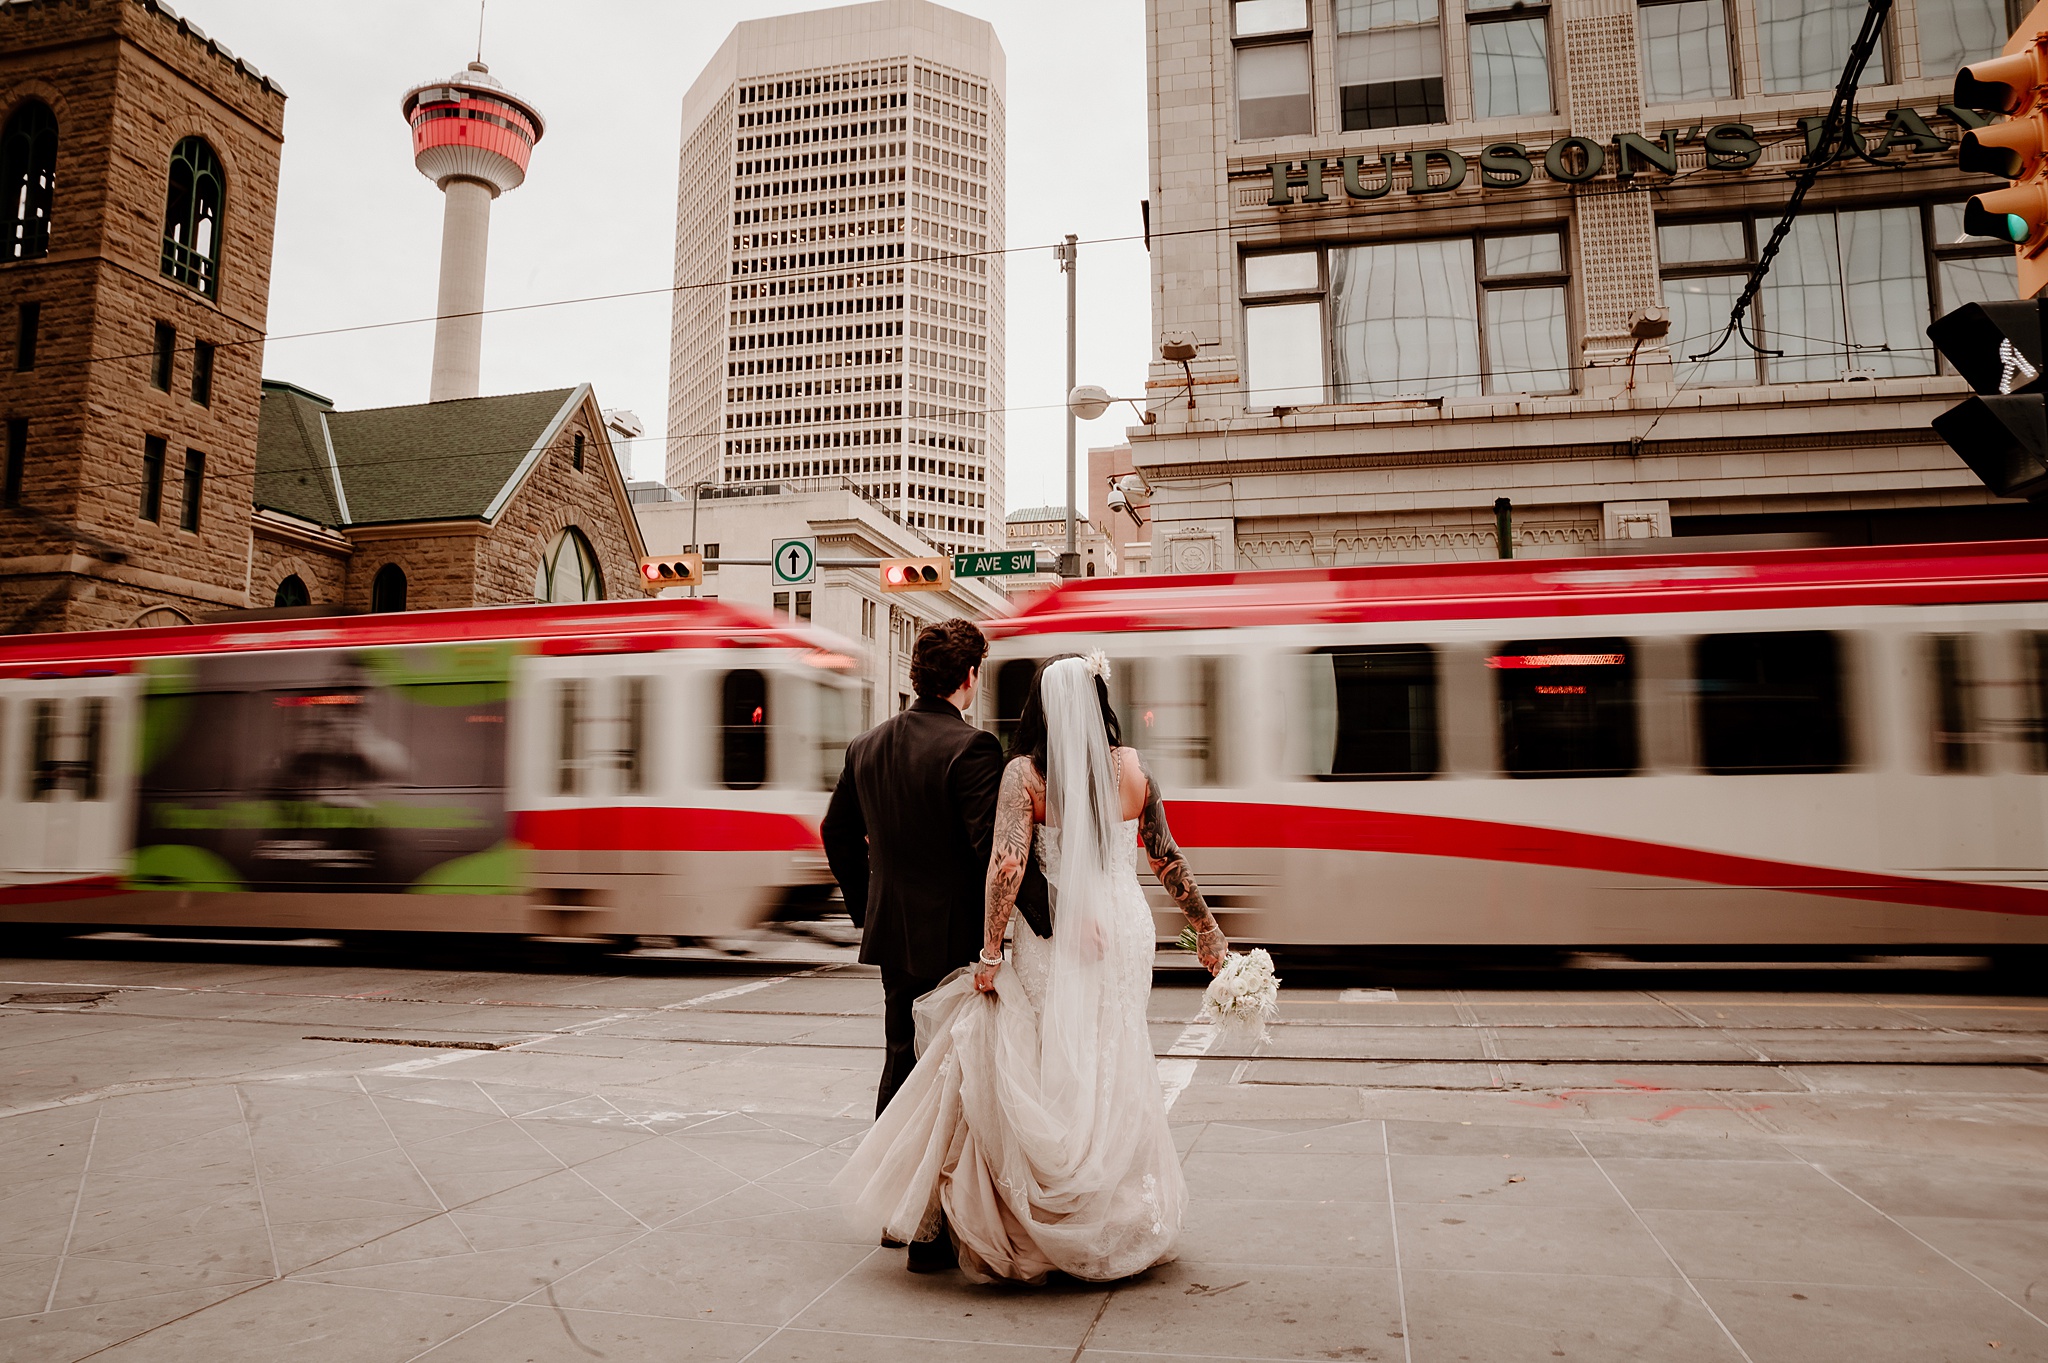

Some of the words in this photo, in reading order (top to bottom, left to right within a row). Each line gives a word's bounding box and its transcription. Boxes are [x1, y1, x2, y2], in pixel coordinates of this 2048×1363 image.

[1266, 123, 1762, 206] HUDSON'S
[1008, 522, 1078, 537] ALLISE
[958, 558, 968, 573] 7
[975, 556, 1002, 572] AVE
[1011, 554, 1031, 570] SW
